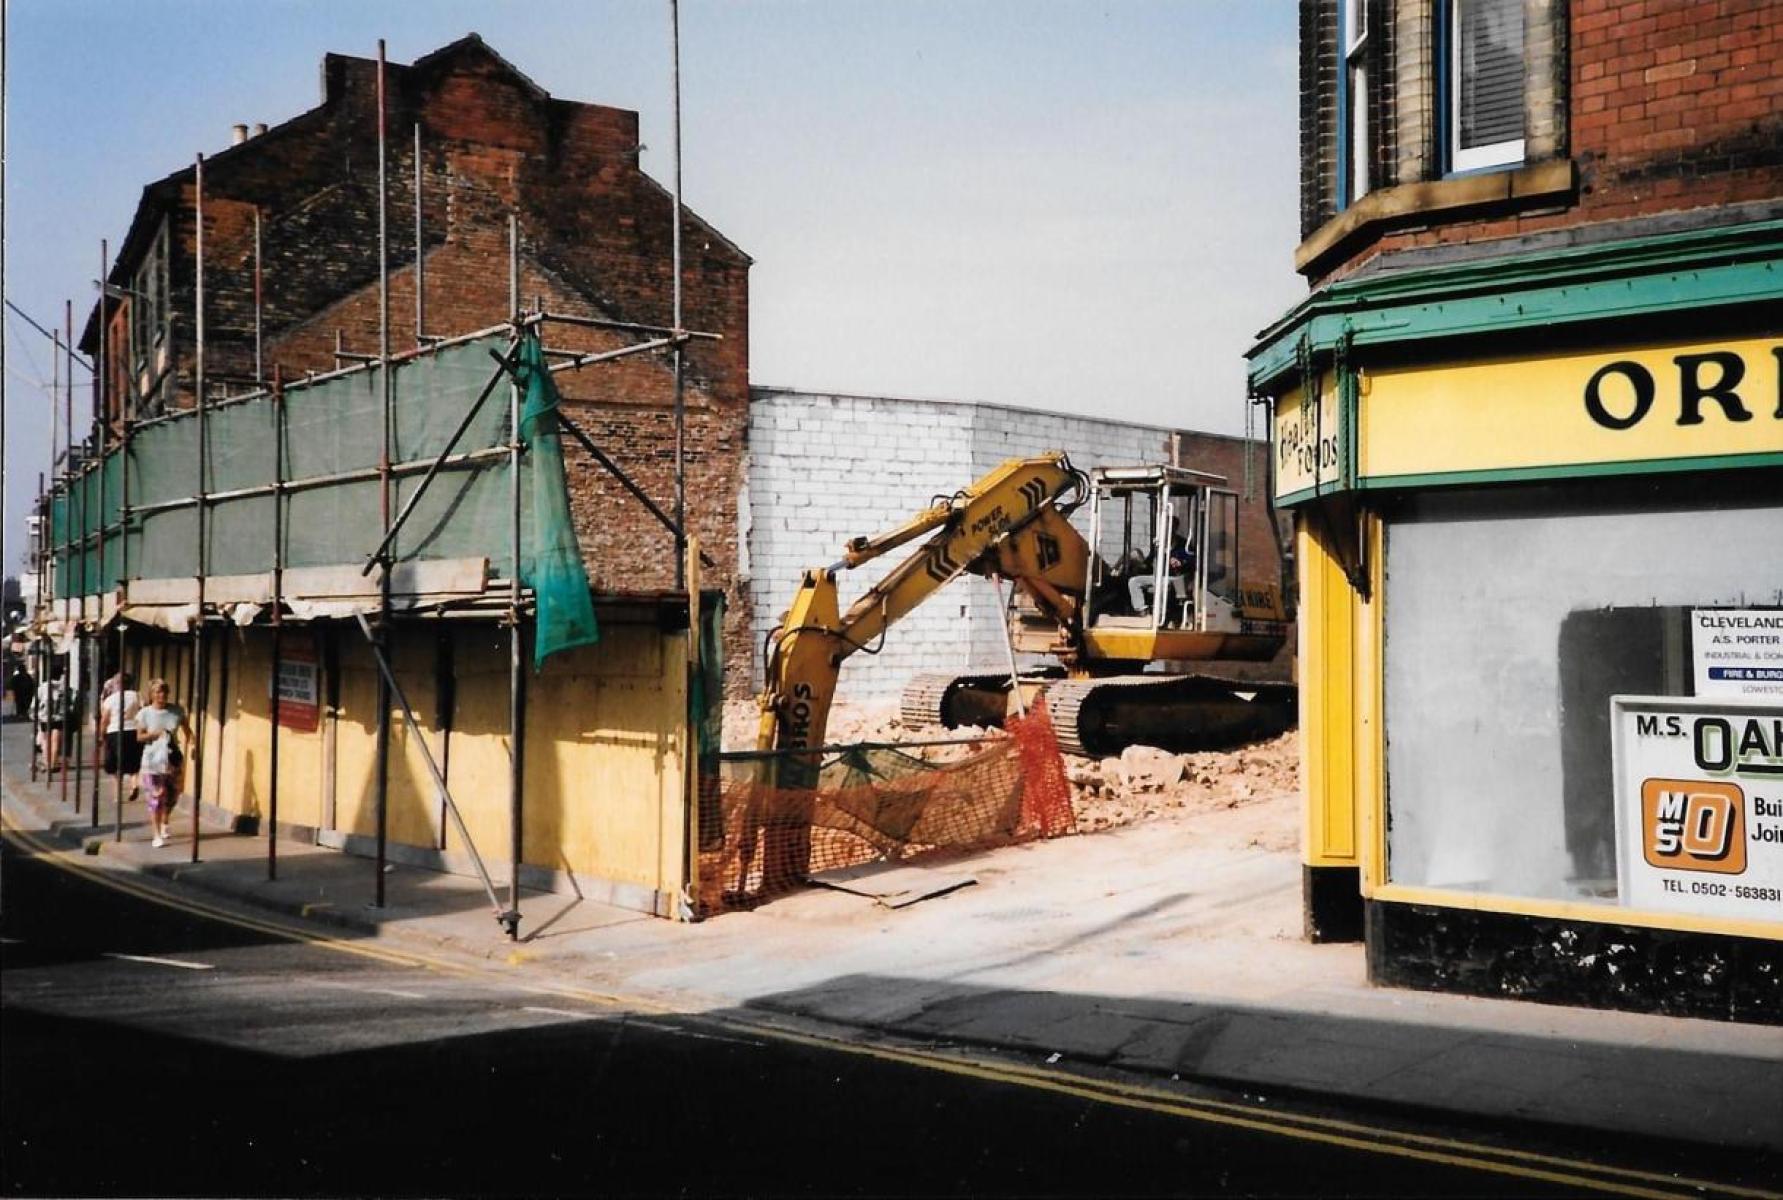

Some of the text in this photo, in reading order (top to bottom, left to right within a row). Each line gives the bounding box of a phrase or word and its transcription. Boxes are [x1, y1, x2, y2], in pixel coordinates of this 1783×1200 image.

[1584, 346, 1783, 431] OR
[1736, 635, 1780, 644] PORTER
[1636, 715, 1688, 737] M.S.
[1662, 879, 1688, 893] TEL.
